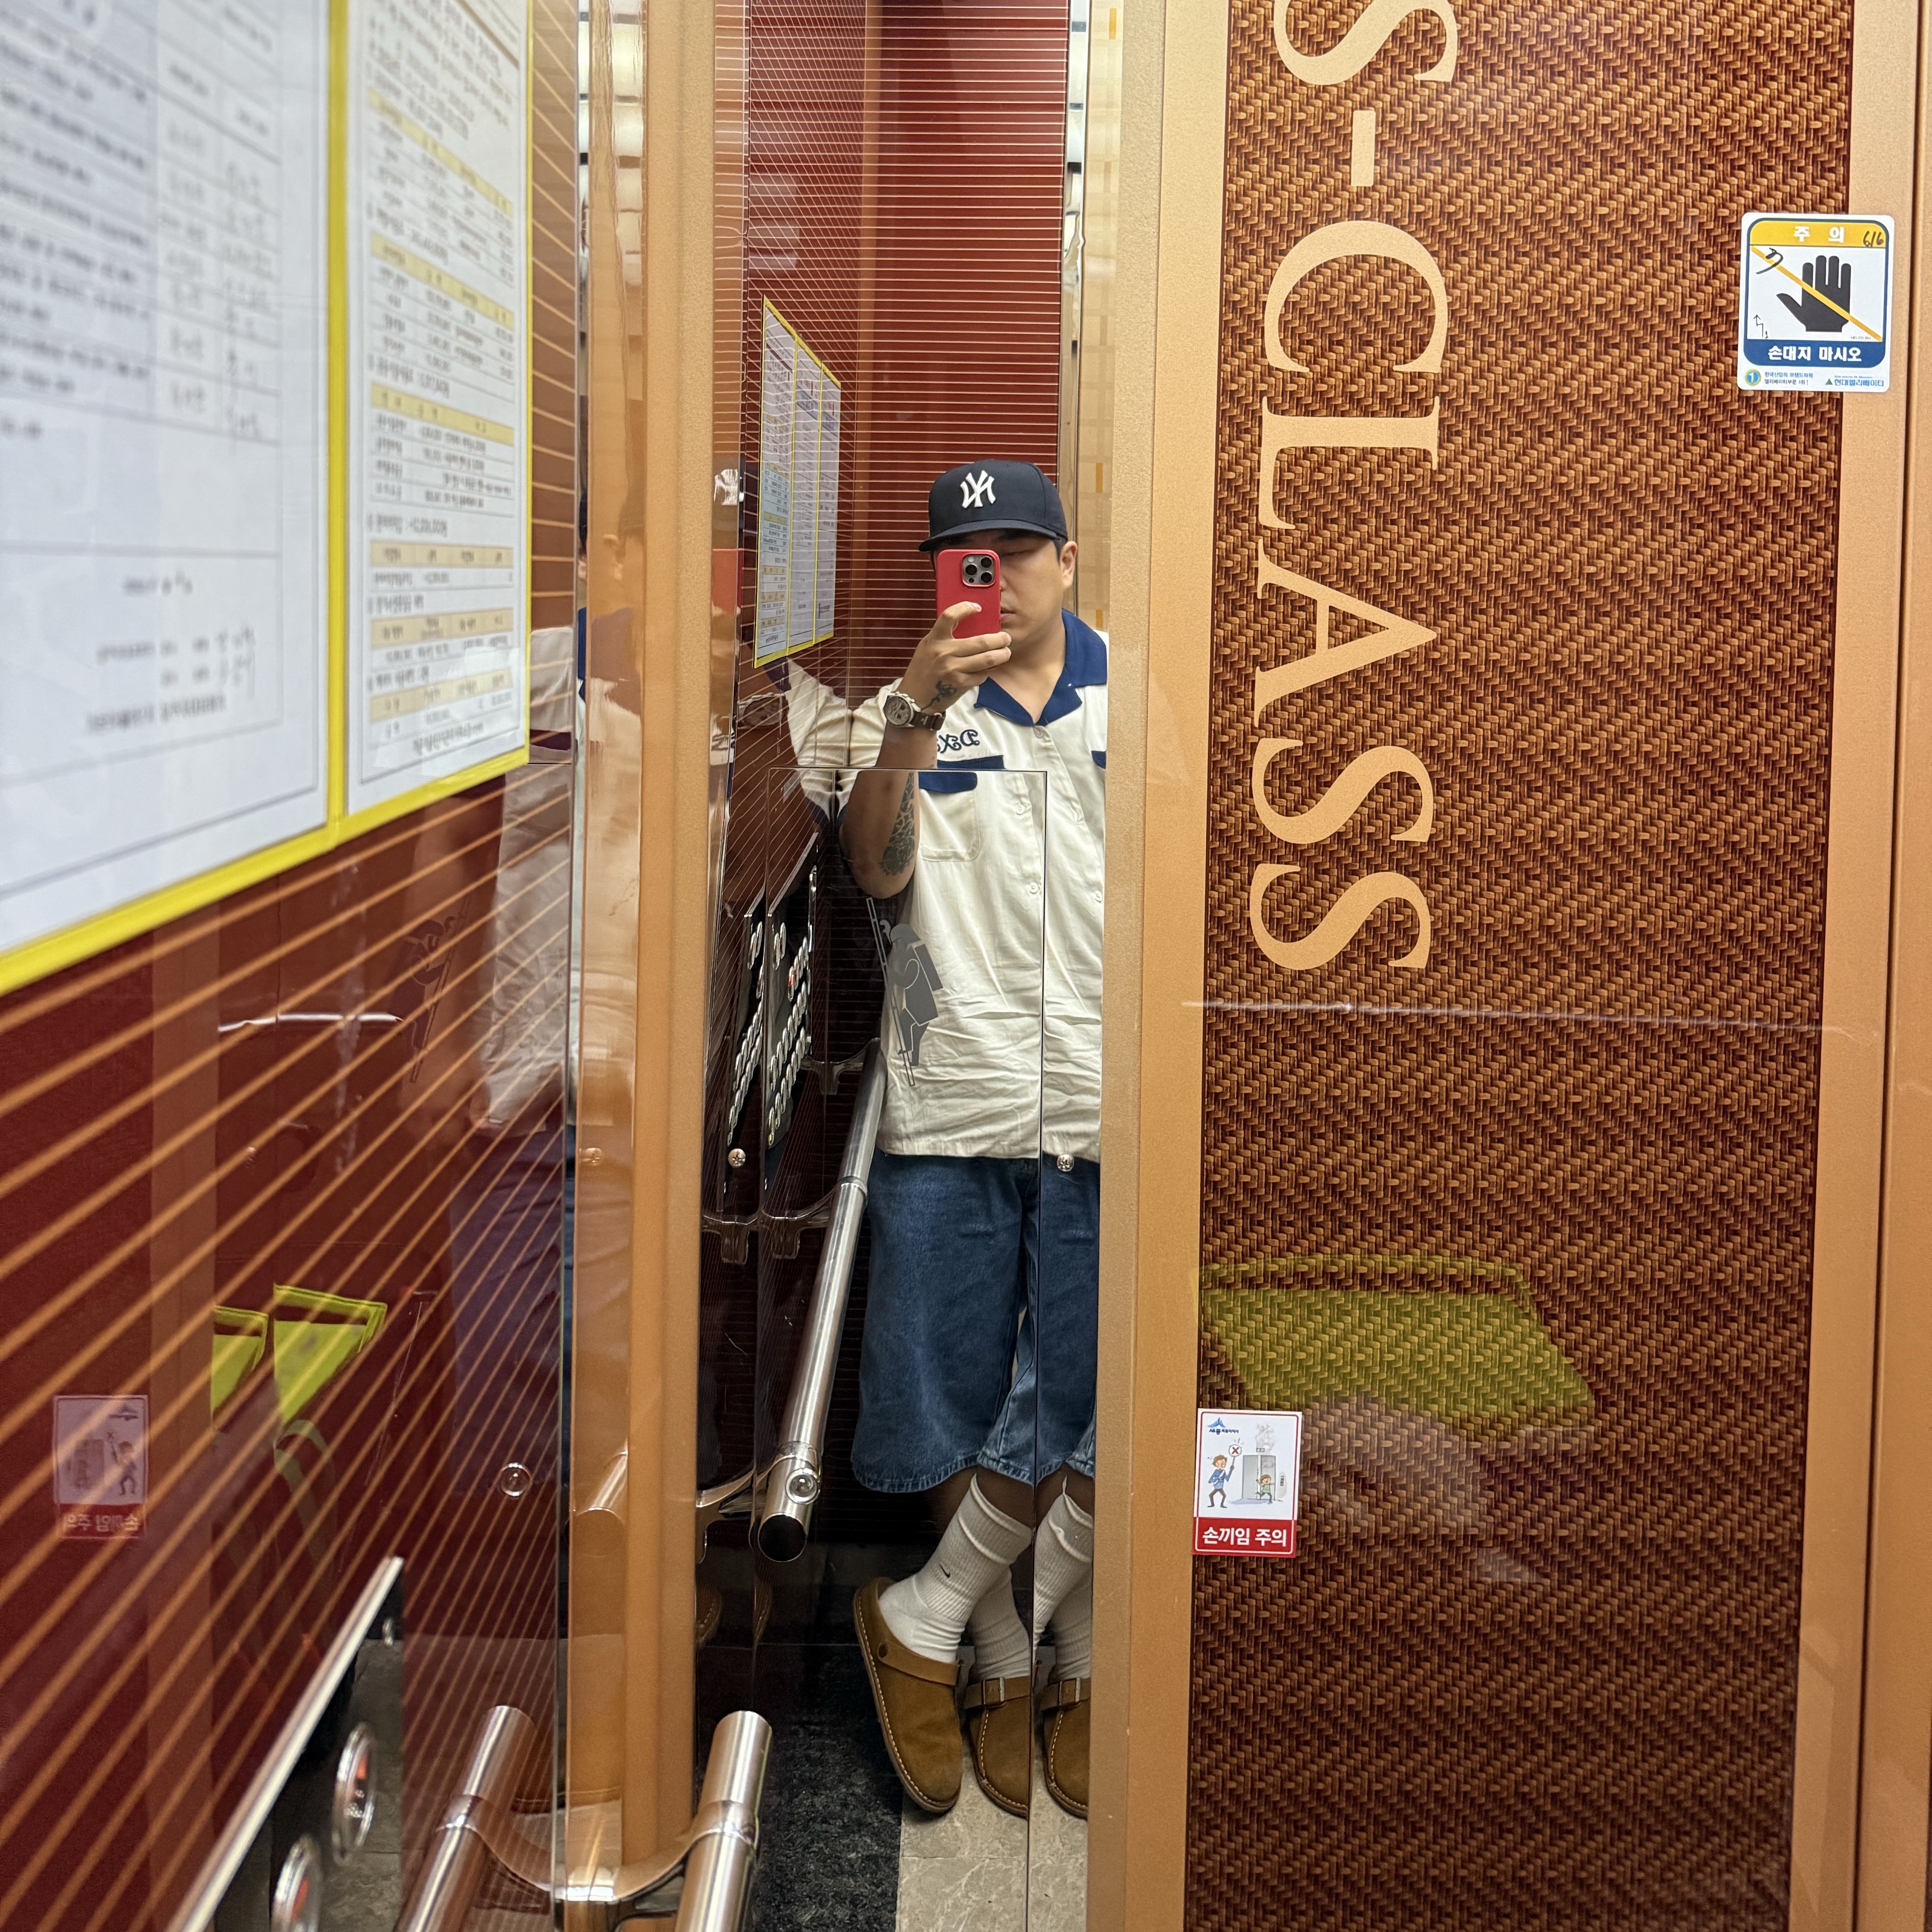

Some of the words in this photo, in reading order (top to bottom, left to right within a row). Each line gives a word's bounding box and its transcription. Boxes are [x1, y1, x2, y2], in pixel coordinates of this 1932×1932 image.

[1768, 345, 1811, 361] 손대지
[1819, 346, 1862, 362] 마시오
[1835, 379, 1884, 387] 현대엘리베이터
[1250, 0, 1459, 971] S-CLASS
[1203, 1527, 1250, 1545] 손끼임
[1255, 1529, 1286, 1547] 주의
